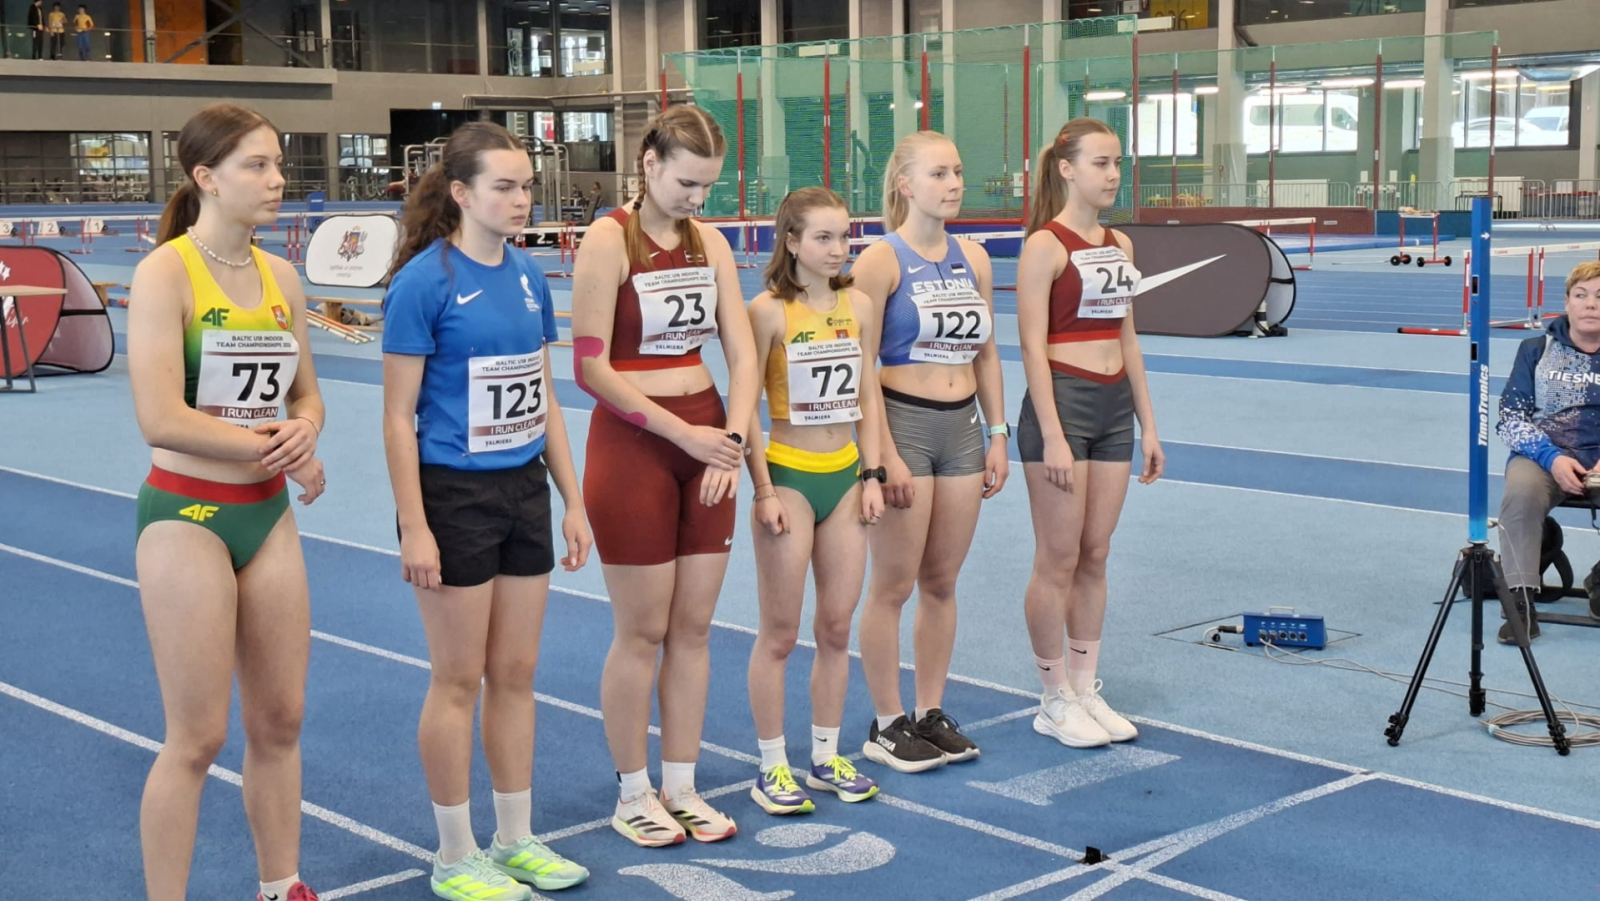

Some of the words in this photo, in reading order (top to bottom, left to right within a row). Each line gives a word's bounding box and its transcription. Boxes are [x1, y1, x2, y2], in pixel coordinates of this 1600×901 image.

[3, 224, 10, 234] 3
[48, 223, 55, 232] 2
[95, 222, 100, 231] 1
[661, 277, 699, 285] CHAMPIONSHIPS
[912, 277, 975, 294] ESTONIA
[1096, 265, 1134, 294] 24
[664, 292, 706, 328] 23
[201, 307, 230, 327] 4F
[932, 310, 981, 340] 122
[665, 332, 687, 340] RUN
[791, 331, 816, 344] 4F
[813, 347, 850, 355] CHAMPIONSHIPS
[933, 342, 952, 350] RUN
[495, 359, 517, 367] BALTIC
[232, 362, 281, 402] 73
[811, 363, 856, 398] 72
[487, 376, 542, 420] 123
[813, 402, 832, 411] RUN
[832, 399, 857, 409] CLEAN
[221, 407, 226, 416] I
[227, 408, 252, 418] RUN
[253, 406, 278, 418] CLEAN
[804, 414, 831, 422] VALMIERA
[495, 424, 514, 435] RUN
[515, 419, 537, 432] CLEAN
[485, 438, 513, 447] VALMIERA
[179, 504, 220, 521] 4F
[876, 733, 897, 753] HOKA
